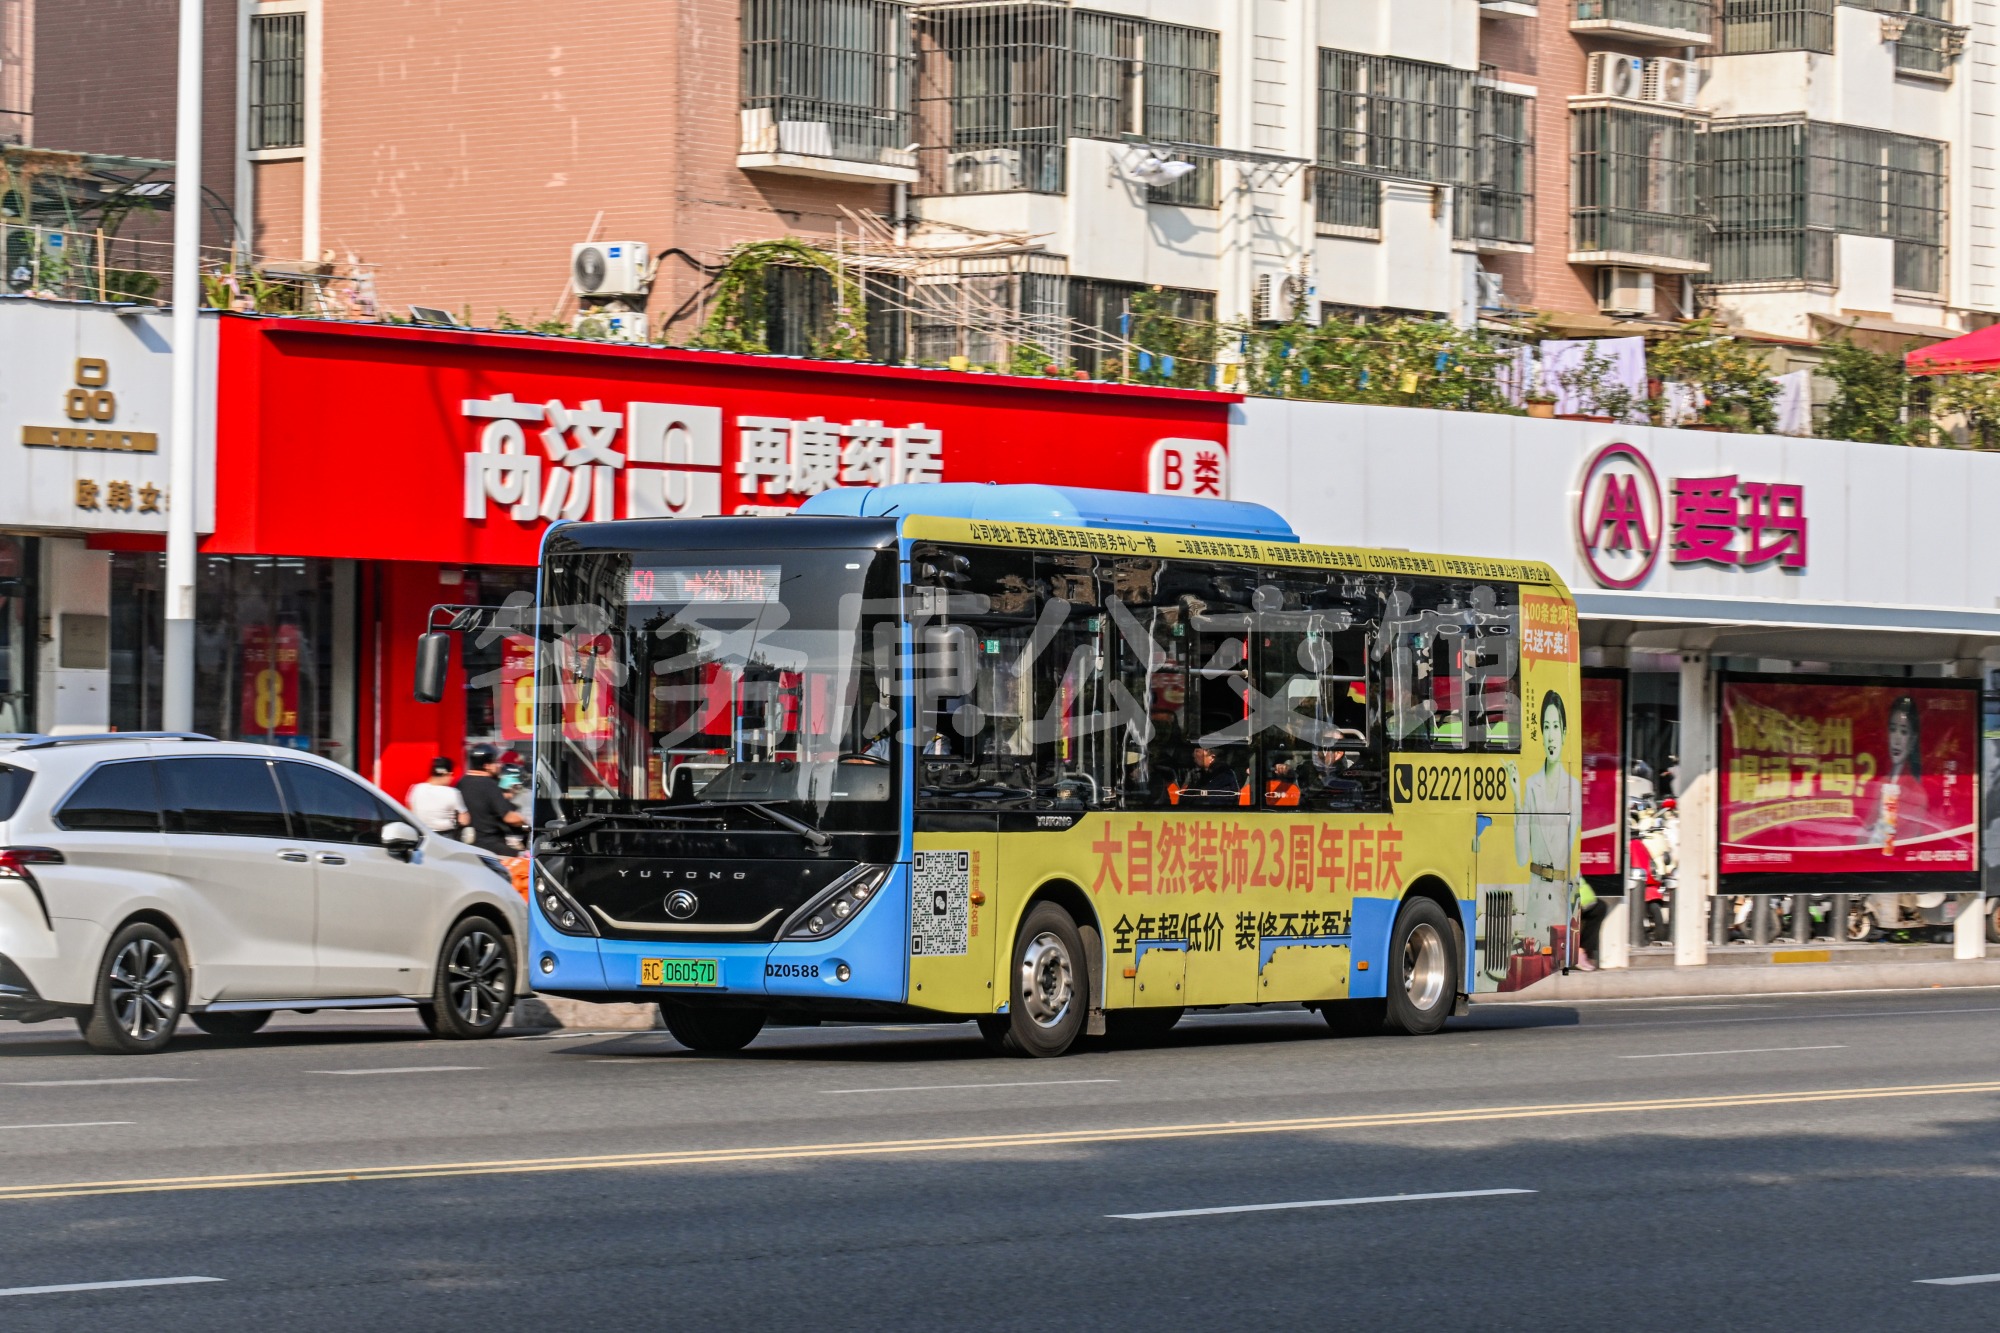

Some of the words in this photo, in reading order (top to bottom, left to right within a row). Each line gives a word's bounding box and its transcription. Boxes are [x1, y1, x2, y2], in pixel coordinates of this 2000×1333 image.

[462, 393, 625, 522] 高济
[736, 416, 943, 498] 再康药房
[1164, 449, 1220, 497] B类
[75, 479, 170, 514] 欧韩女
[1671, 475, 1809, 571] 爱玛
[633, 570, 655, 602] 50
[1523, 628, 1569, 655] 只送不卖！
[1417, 765, 1507, 801] 82221888
[1035, 815, 1073, 827] YUTONG
[618, 869, 746, 880] YUTONG
[1092, 820, 1403, 896] 大自然装饰23周年店庆
[1112, 912, 1225, 954] 全年超低价
[766, 963, 820, 978] DZ0588
